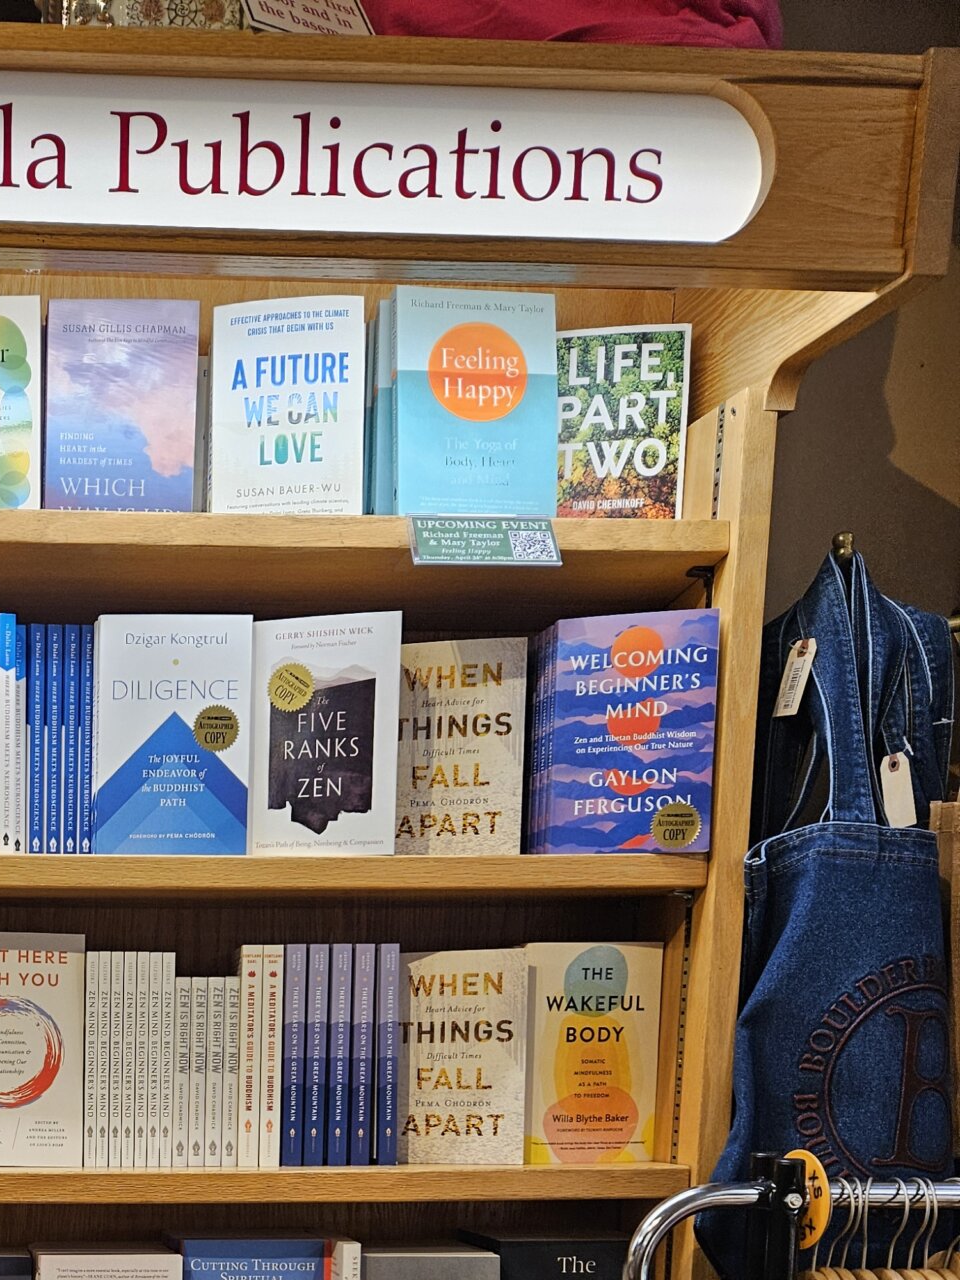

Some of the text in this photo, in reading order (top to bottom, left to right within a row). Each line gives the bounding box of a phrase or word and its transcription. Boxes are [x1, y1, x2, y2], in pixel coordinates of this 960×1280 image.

[260, 2, 285, 19] the
[303, 4, 352, 29] and in
[109, 111, 663, 205] Publications
[63, 324, 186, 334] SUSAN GILLIS CHAPMAN
[232, 353, 349, 390] A FUTURE
[441, 348, 519, 377] Feeling
[568, 343, 675, 387] LIFE,
[444, 379, 516, 407] Happy
[260, 432, 322, 466] LOVE
[558, 438, 667, 479] TWO
[573, 499, 644, 510] DAVID CHERNIKOFF
[417, 520, 548, 530] UPCOMING EVENT
[125, 632, 227, 648] Dzigar Kongtrul
[570, 647, 708, 671] WELCOMING
[112, 680, 239, 700] DILIGENCE
[575, 673, 701, 696] BEGINNER'S
[605, 701, 668, 719] MIND
[297, 712, 346, 733] FIVE
[284, 737, 359, 759] RANKS
[298, 777, 342, 798] ZEN
[17, 950, 68, 964] HERE
[582, 968, 613, 980] THE
[547, 996, 644, 1012] WAKEFUL
[800, 960, 919, 1073] BOULDER
[179, 987, 189, 1075] ZEN IS RIGHT NOW
[398, 1020, 514, 1044] THINGS
[566, 1027, 624, 1043] BODY
[416, 1068, 492, 1090] FALL
[401, 1114, 504, 1137] APART
[552, 1114, 629, 1126] Willa Blythe Baker
